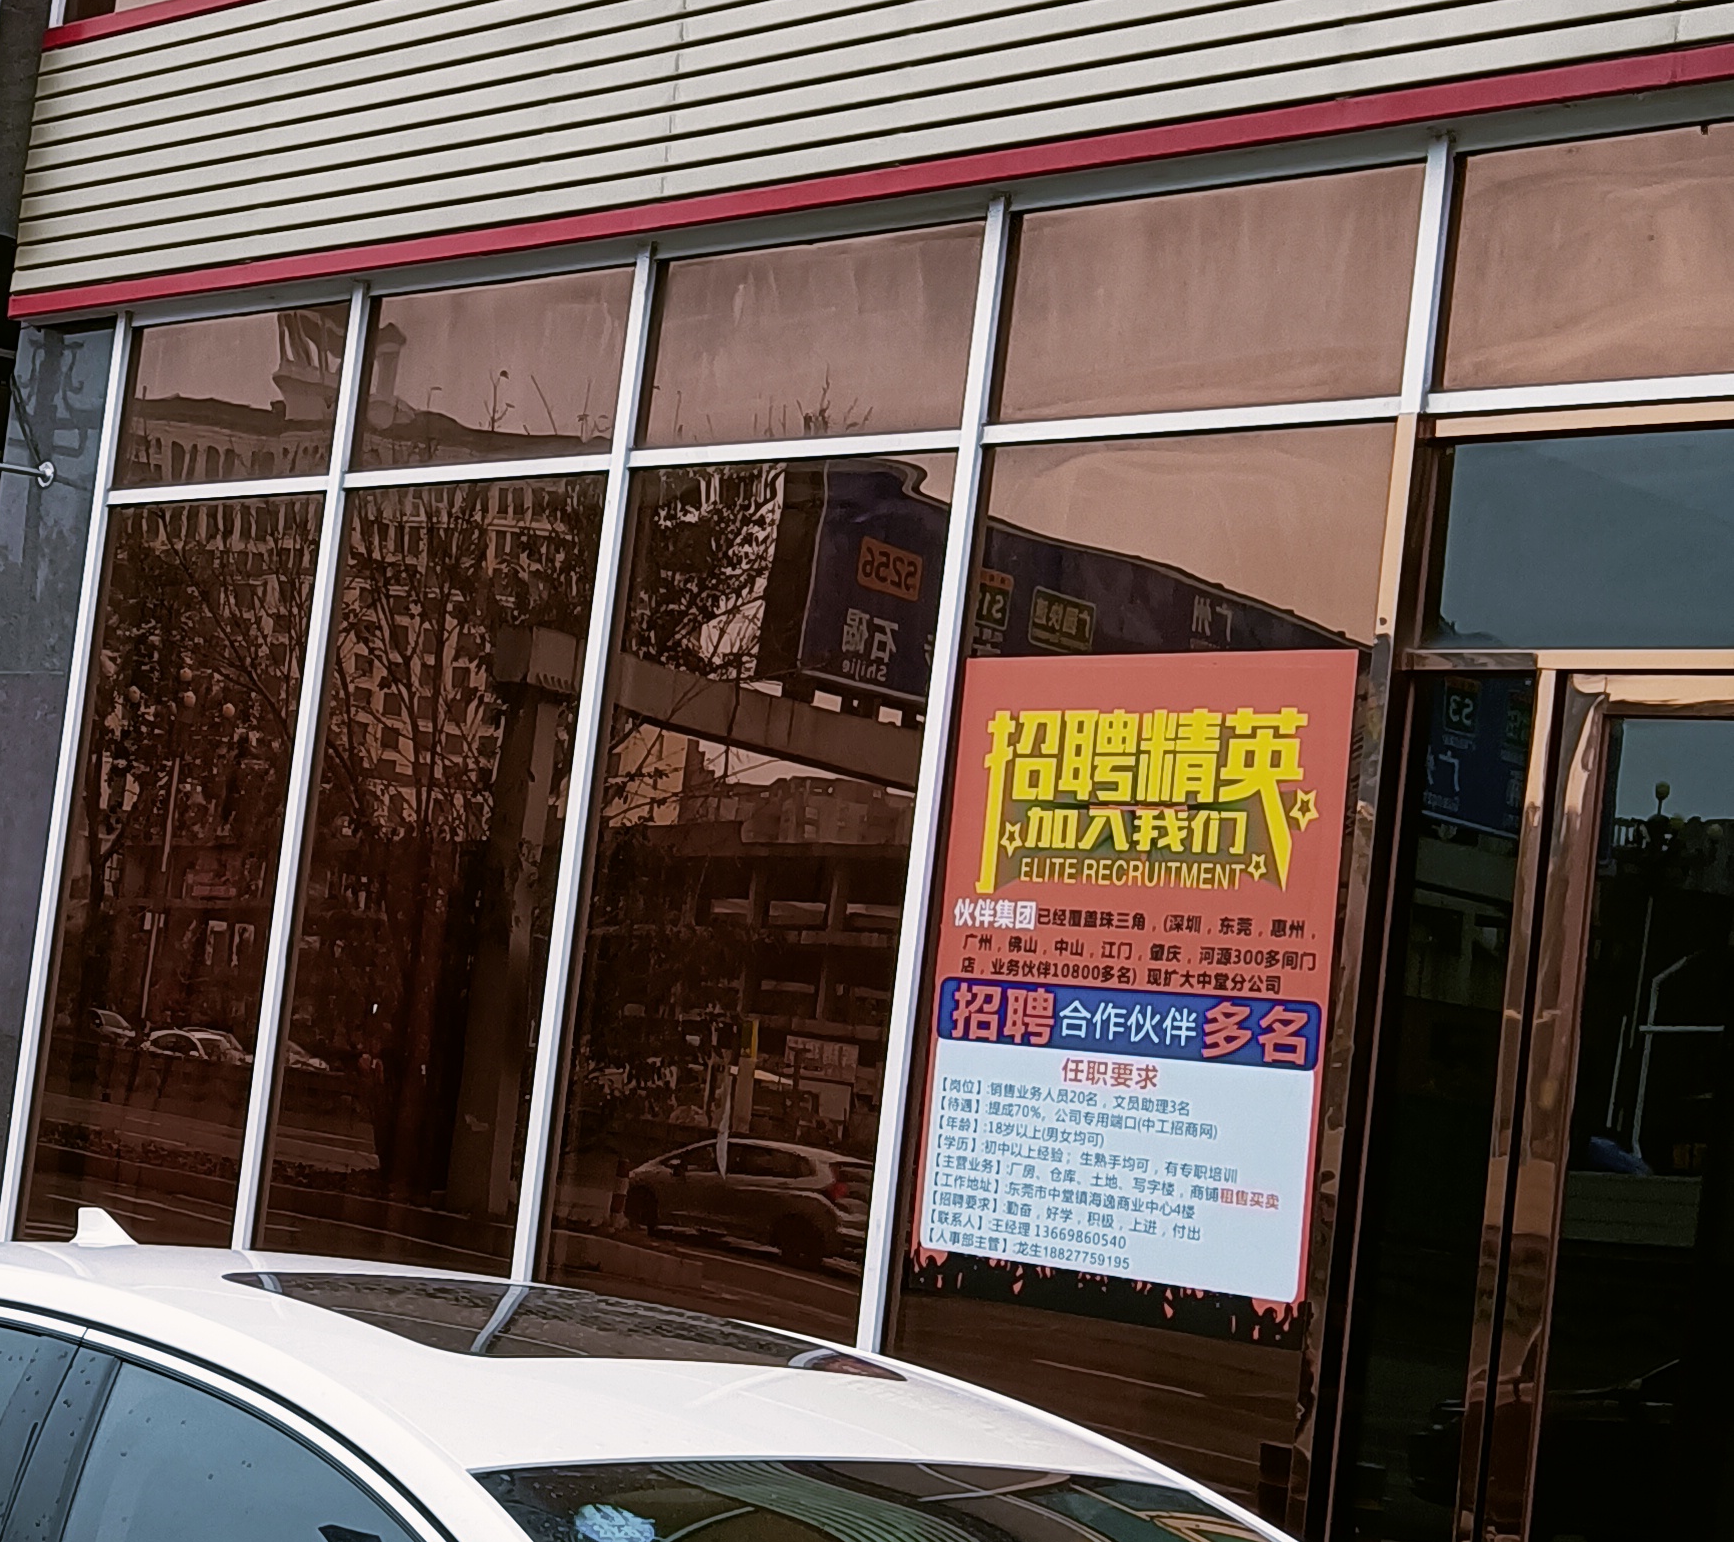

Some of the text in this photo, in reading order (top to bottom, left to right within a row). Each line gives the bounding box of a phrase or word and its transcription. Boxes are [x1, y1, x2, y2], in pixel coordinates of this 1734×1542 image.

[975, 708, 1309, 894] 招聘精英
[1024, 807, 1247, 855] 加入我们
[1020, 858, 1246, 891] ELITE RECRUITMENT
[953, 898, 1037, 930] 伙伴集团
[951, 982, 1310, 1065] 招聘 合作伙伴 多名
[1061, 1057, 1159, 1090] 任职要求
